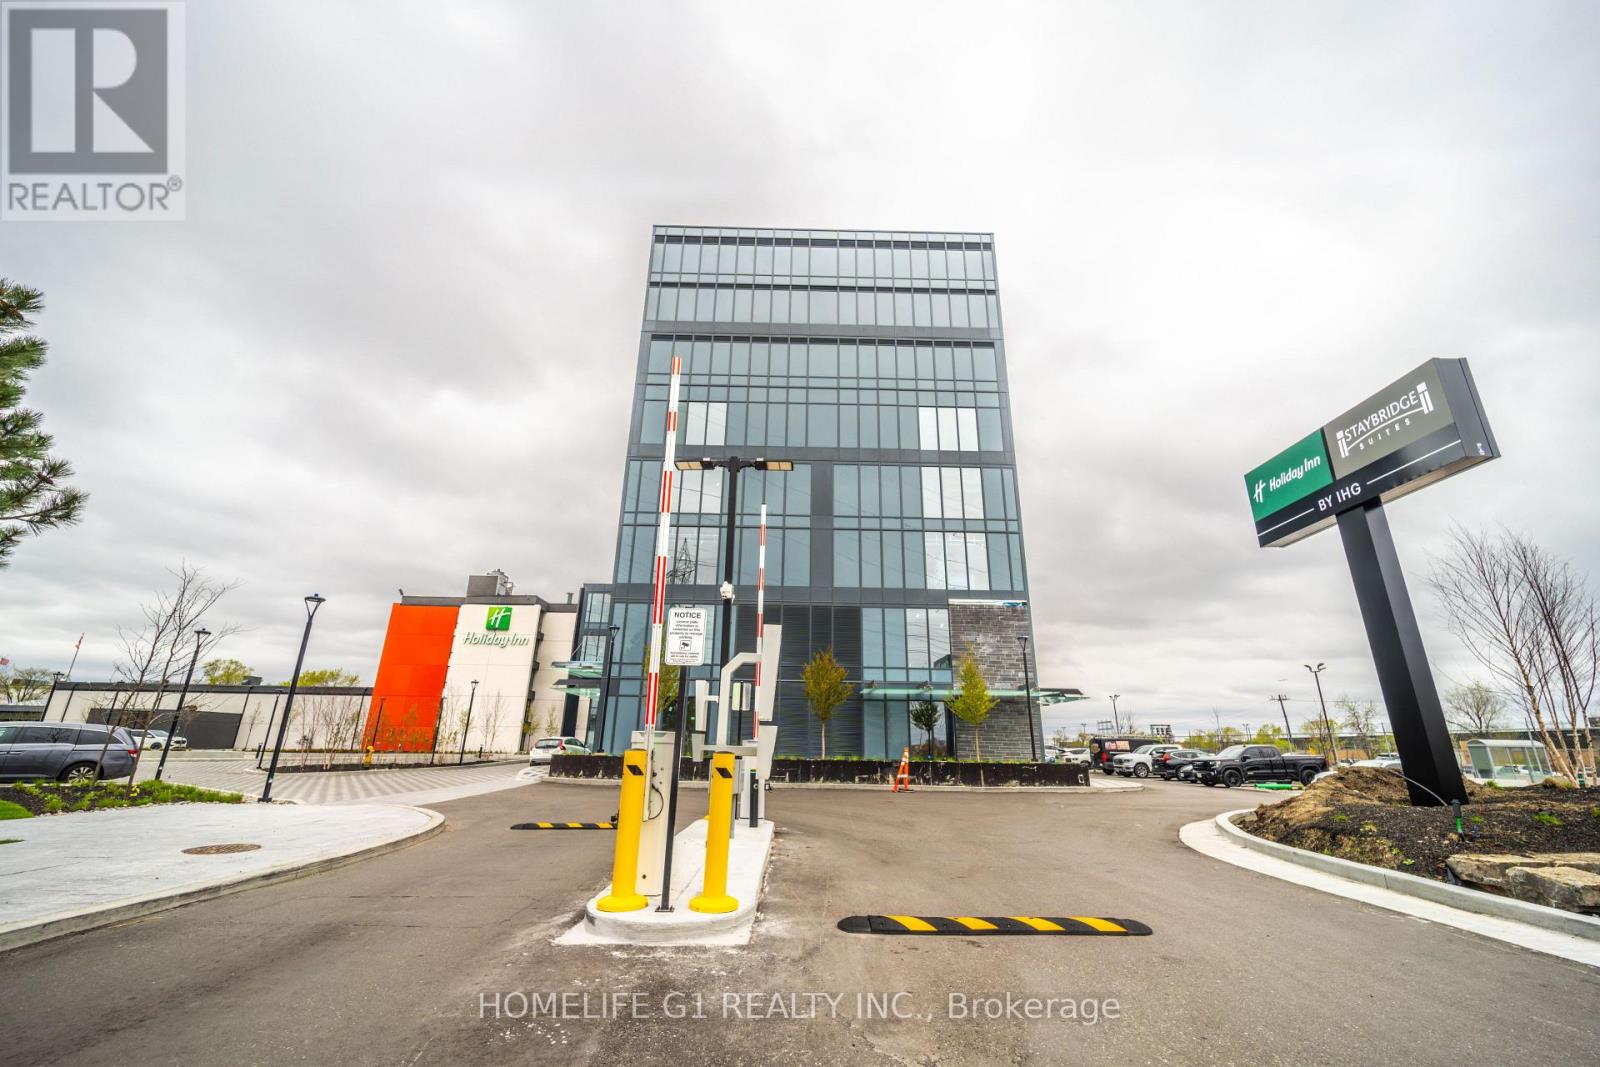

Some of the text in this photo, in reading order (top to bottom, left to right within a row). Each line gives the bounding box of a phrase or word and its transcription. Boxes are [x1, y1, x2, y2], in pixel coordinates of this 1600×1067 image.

[1344, 390, 1419, 442] STAYBRIDGE
[1359, 417, 1411, 450] SUITES
[1269, 455, 1321, 492] Holiday Inn
[1317, 482, 1362, 511] BY IHG
[674, 611, 702, 619] NOTICE
[463, 631, 530, 648] Holiday Inn
